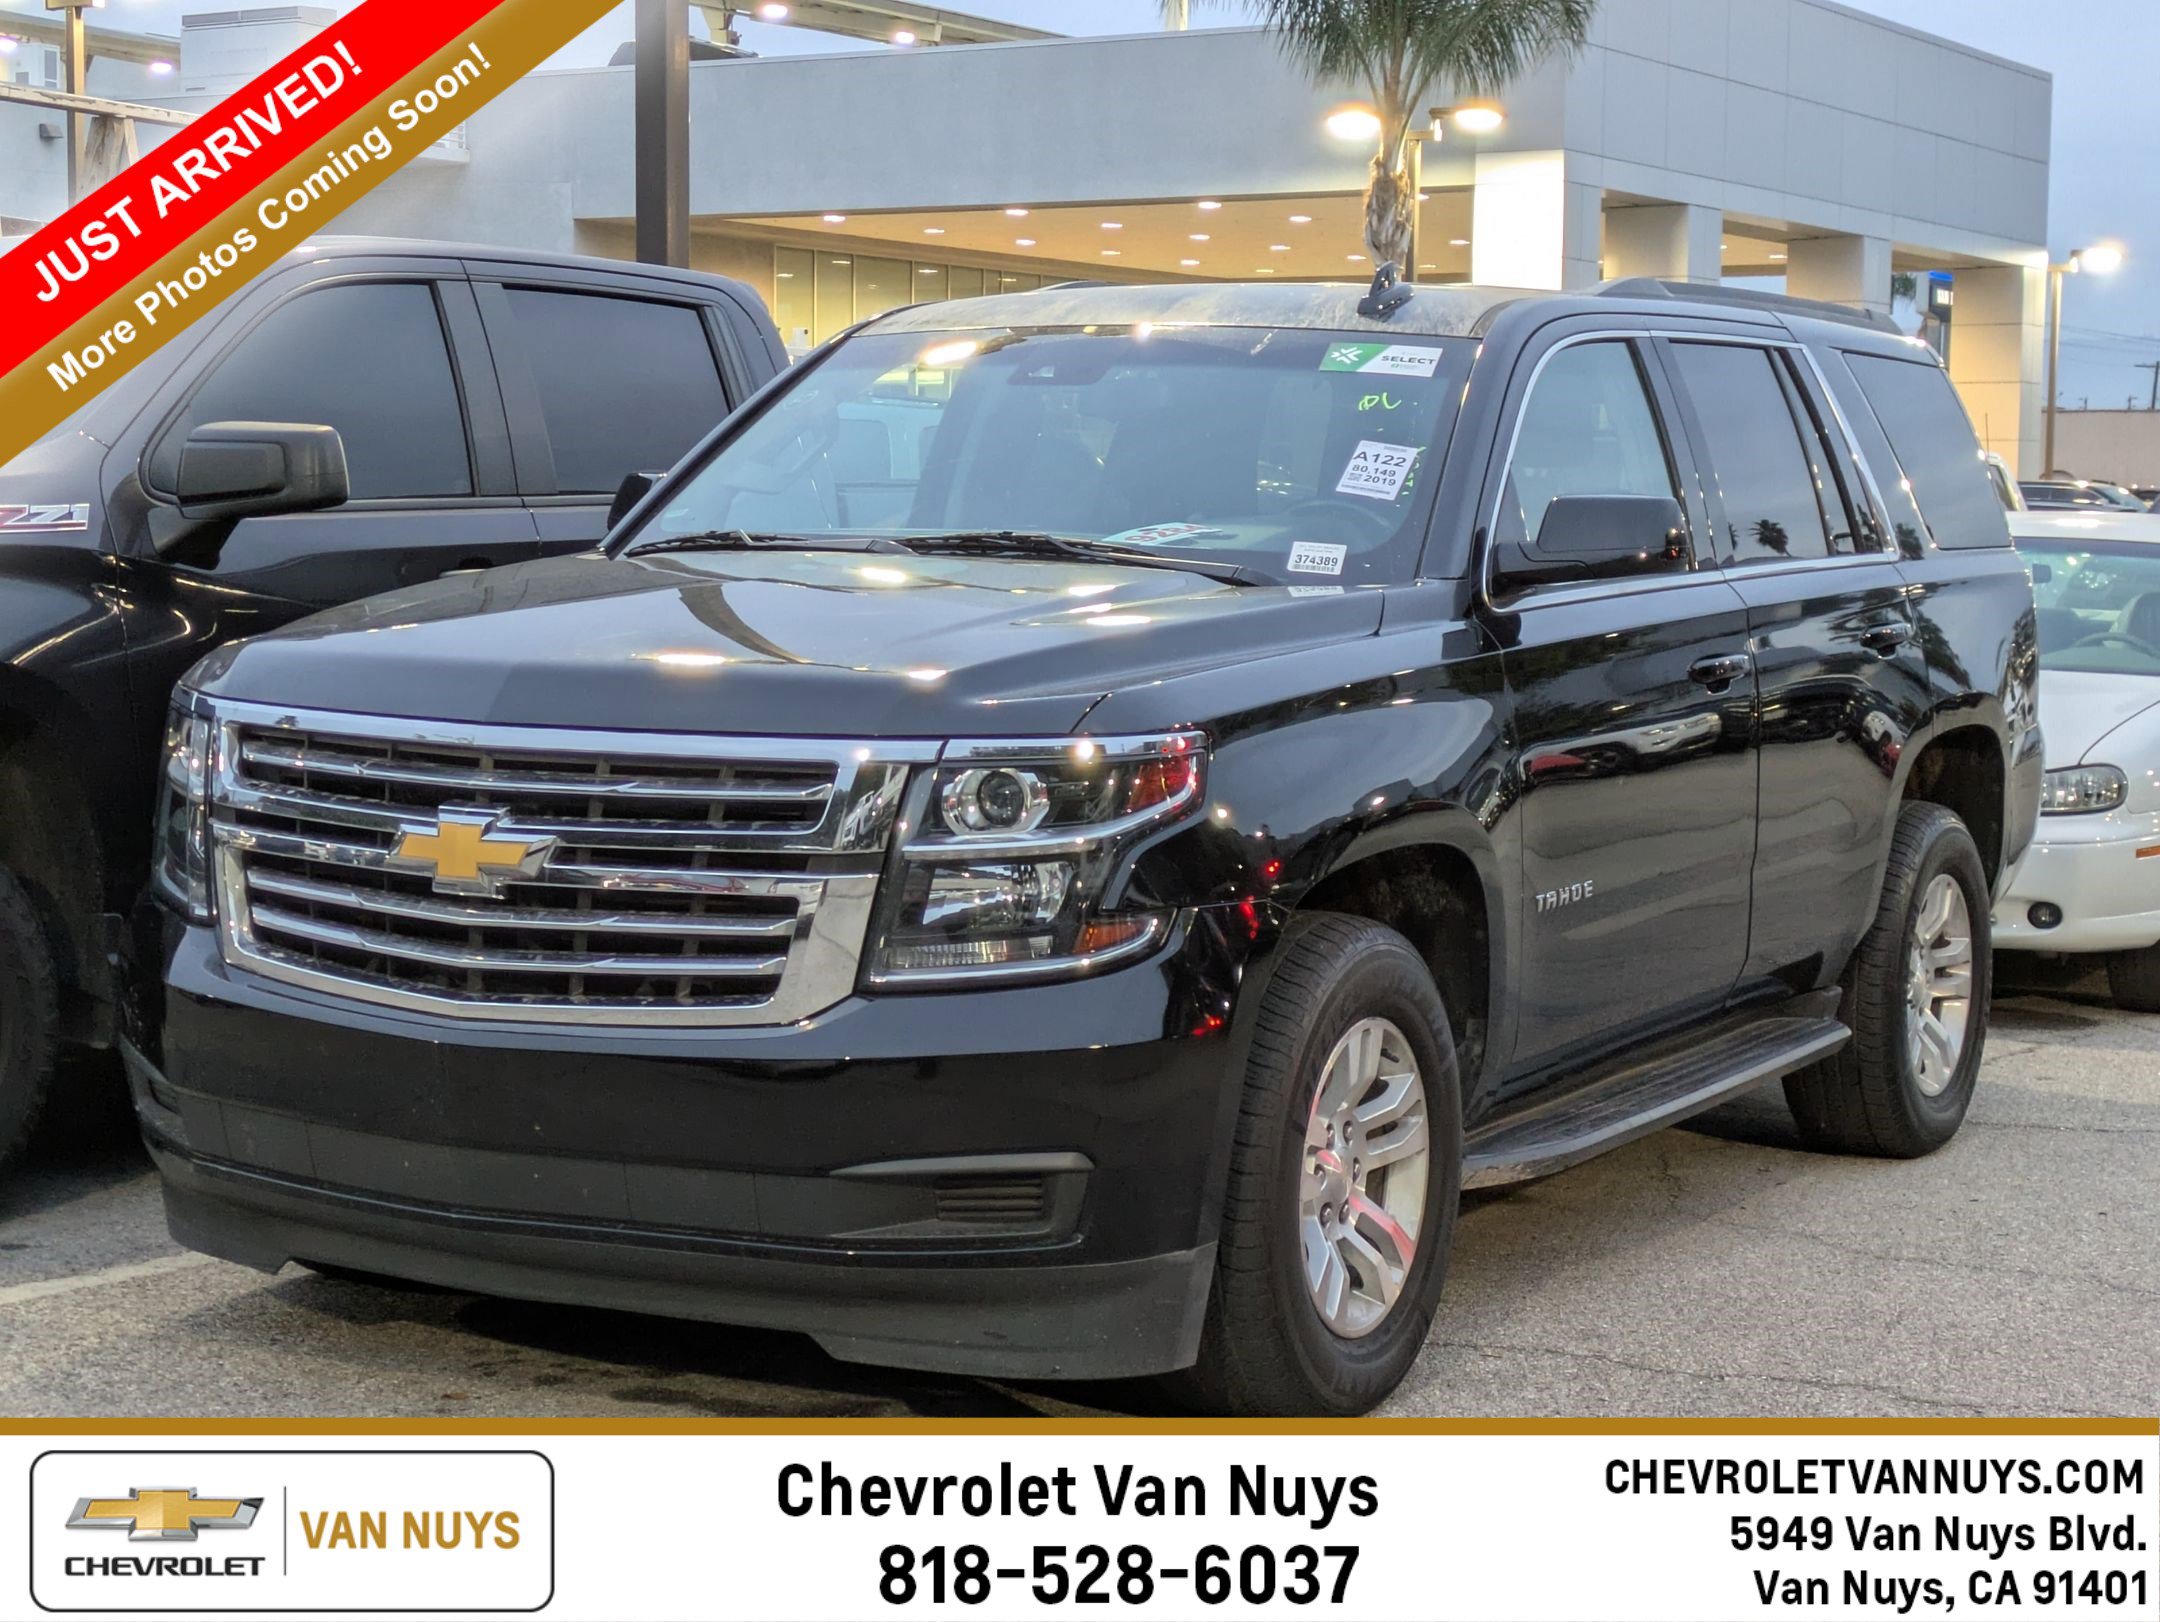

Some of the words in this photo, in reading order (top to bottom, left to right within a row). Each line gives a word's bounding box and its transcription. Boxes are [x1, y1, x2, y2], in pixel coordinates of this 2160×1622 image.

[1381, 354, 1436, 365] SELECT
[1352, 451, 1407, 467] A122
[1352, 464, 1397, 478] 80,149
[1363, 474, 1397, 487] 2019
[1294, 554, 1338, 567] 374389
[1535, 880, 1593, 912] TAHOE
